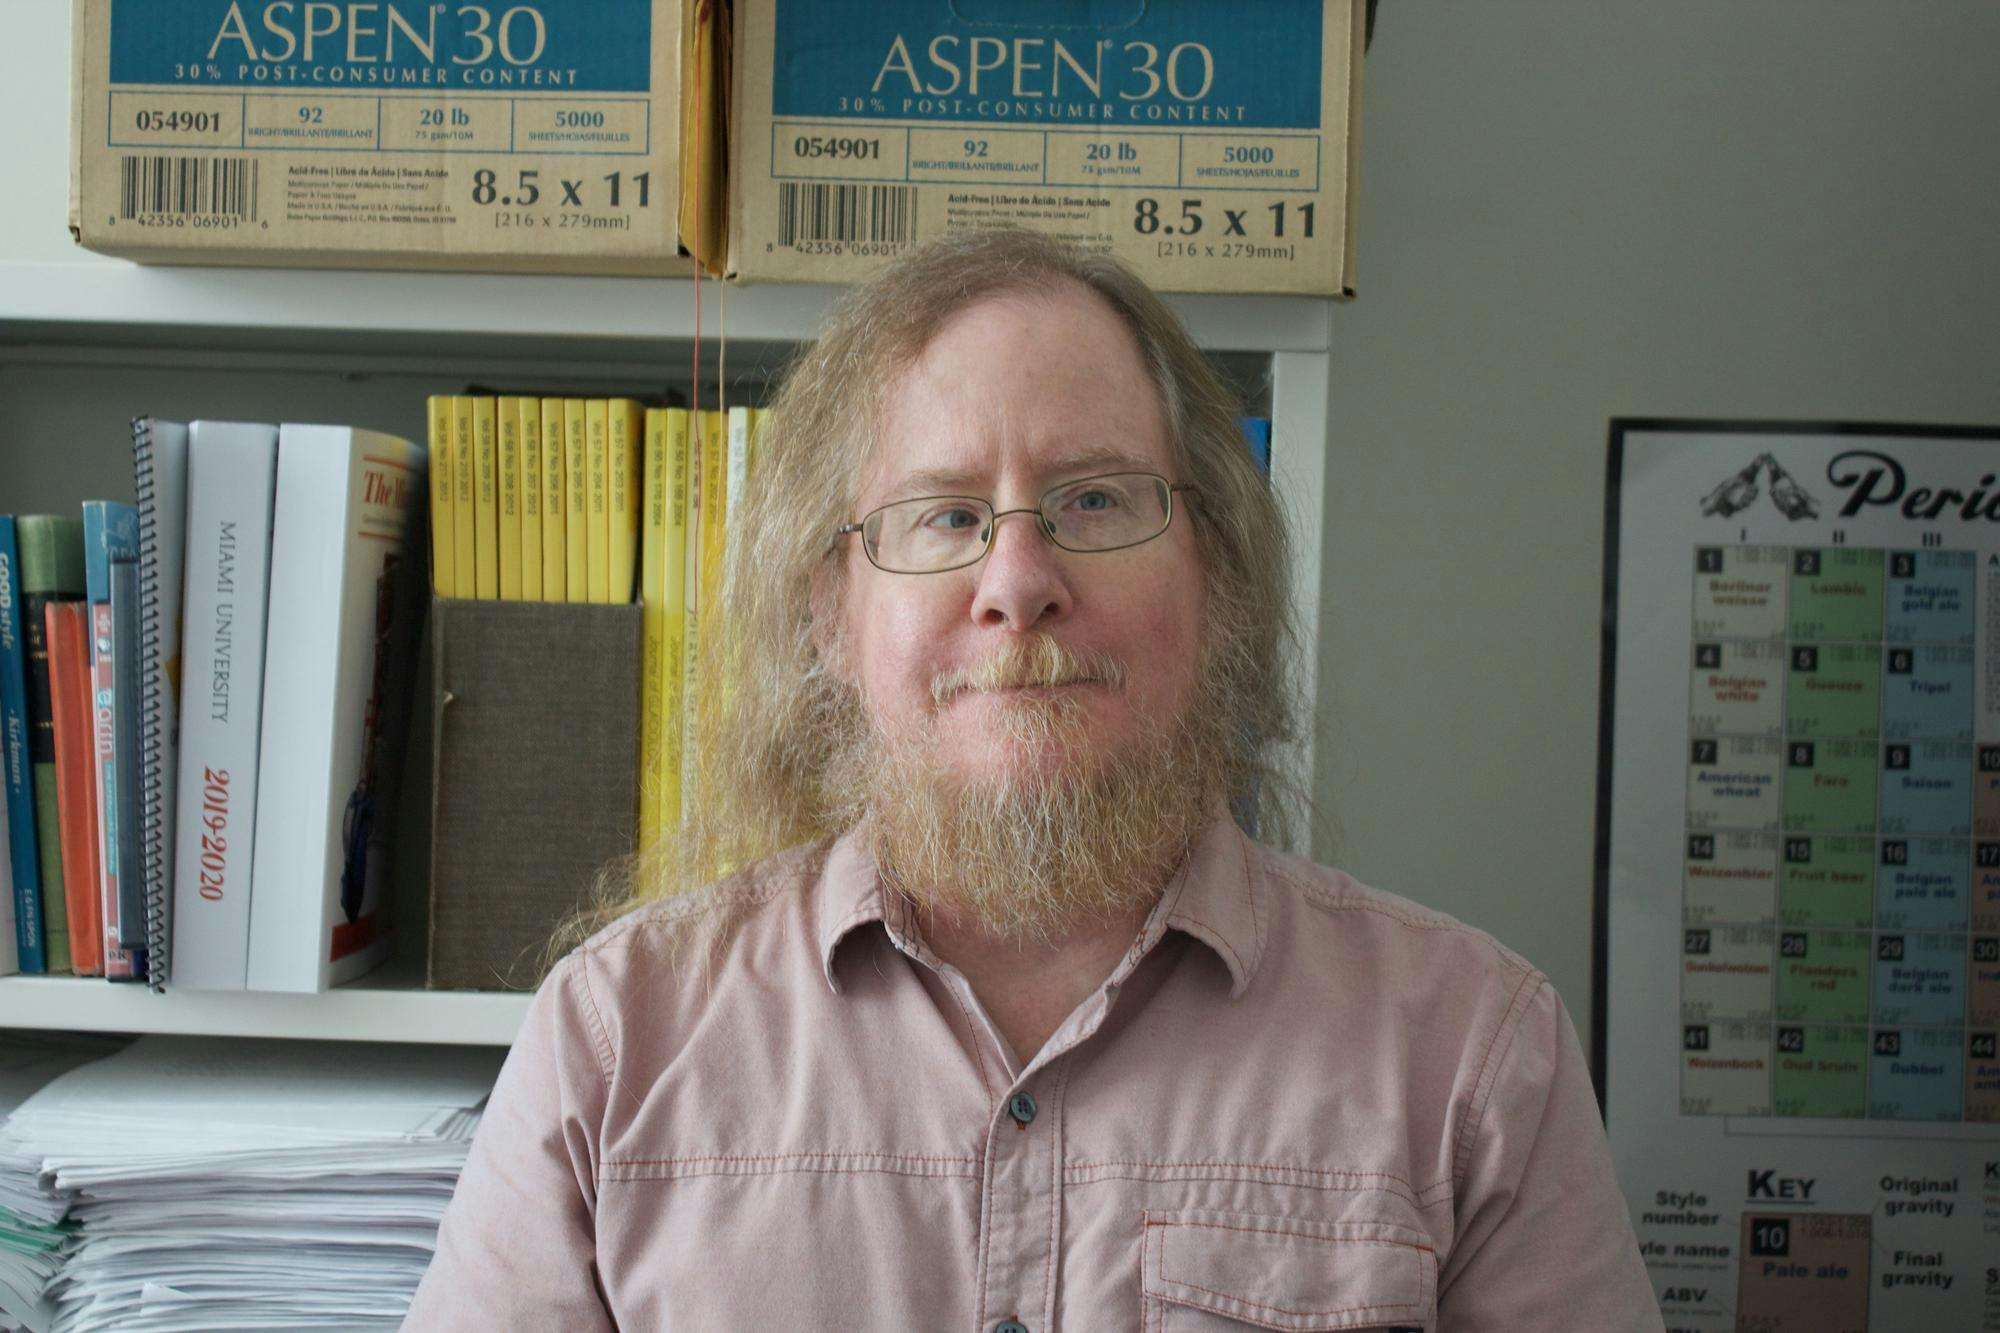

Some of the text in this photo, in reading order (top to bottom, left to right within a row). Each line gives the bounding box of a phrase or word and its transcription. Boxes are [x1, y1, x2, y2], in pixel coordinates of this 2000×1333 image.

[452, 5, 546, 66] 30
[174, 63, 577, 85] 30% POST-CONSUMER CONTENT
[1120, 40, 1214, 101] 30
[299, 107, 323, 124] 92
[420, 108, 470, 126] 20 lb
[839, 97, 1247, 121] 30% POST-CONSUMER CONTENT
[135, 110, 220, 133] 054901
[554, 111, 605, 128] 5000
[794, 136, 880, 160] 054901
[963, 140, 988, 157] 92
[1086, 143, 1137, 161] 20 lb
[1223, 146, 1274, 163] 5000
[471, 168, 650, 207] 8.5 x 11
[109, 213, 269, 230] 8 42356 06901 6
[495, 213, 631, 231] [216 x 279mm]
[1134, 198, 1315, 238] 8.5 x 11
[766, 243, 773, 253] 8
[795, 241, 842, 255] 42356
[1157, 242, 1295, 261] [216 x 279mm]
[1740, 528, 1942, 547] I II III
[1801, 555, 1813, 572] 2
[1896, 557, 1908, 573] 3
[1709, 580, 1771, 593] Berliner
[1904, 584, 1960, 600] Belgian
[1901, 598, 1960, 614] gold ale
[0, 611, 15, 649] style
[212, 521, 237, 724] MIAMI UNIVERSITY
[1702, 648, 1714, 664] 4
[1799, 651, 1810, 668] 5
[1894, 653, 1906, 670] 6
[1708, 675, 1767, 691] Belgian
[1909, 679, 1951, 695] Tripel
[1714, 689, 1759, 702] white
[9, 717, 22, 785] Kirkman
[1699, 743, 1709, 759] 7
[1795, 745, 1806, 763] 8
[1892, 748, 1903, 765] 9
[1697, 770, 1771, 785] American
[1902, 775, 1953, 790] Saison
[1712, 785, 1761, 798] wheat
[199, 766, 230, 902] 2019-2020
[1692, 838, 1712, 856] 14
[1788, 841, 1808, 859] 15
[1884, 844, 1905, 862] 16
[1789, 870, 1867, 883] Fruit beer
[1895, 872, 1952, 887] Belgian
[1895, 885, 1956, 900] pale ale
[1687, 934, 1709, 952] 27
[1783, 937, 1806, 955] 28
[1880, 939, 1903, 958] 29
[1975, 941, 1998, 959] 30
[1789, 964, 1857, 979] Flanders
[1891, 967, 1950, 983] Belgian
[1809, 978, 1836, 992] red
[1888, 980, 1952, 995] dark ale
[1686, 1028, 1708, 1047] 41
[1778, 1030, 1801, 1048] 42
[1875, 1034, 1898, 1053] 43
[1972, 1036, 1994, 1055] 44
[1782, 1059, 1859, 1073] Oud bruin
[1890, 1061, 1945, 1075] Dubbel
[1747, 1169, 1816, 1200] KEY
[1880, 1175, 1959, 1196] Original
[1655, 1190, 1708, 1208] Style
[1884, 1198, 1955, 1217] gravity
[1642, 1211, 1720, 1227] number
[1757, 1226, 1785, 1250] 10
[1673, 1244, 1730, 1258] name
[1893, 1250, 1943, 1267] Final
[1763, 1262, 1849, 1279] Pale ale
[1881, 1270, 1954, 1290] gravity
[1663, 1287, 1708, 1303] ABV
